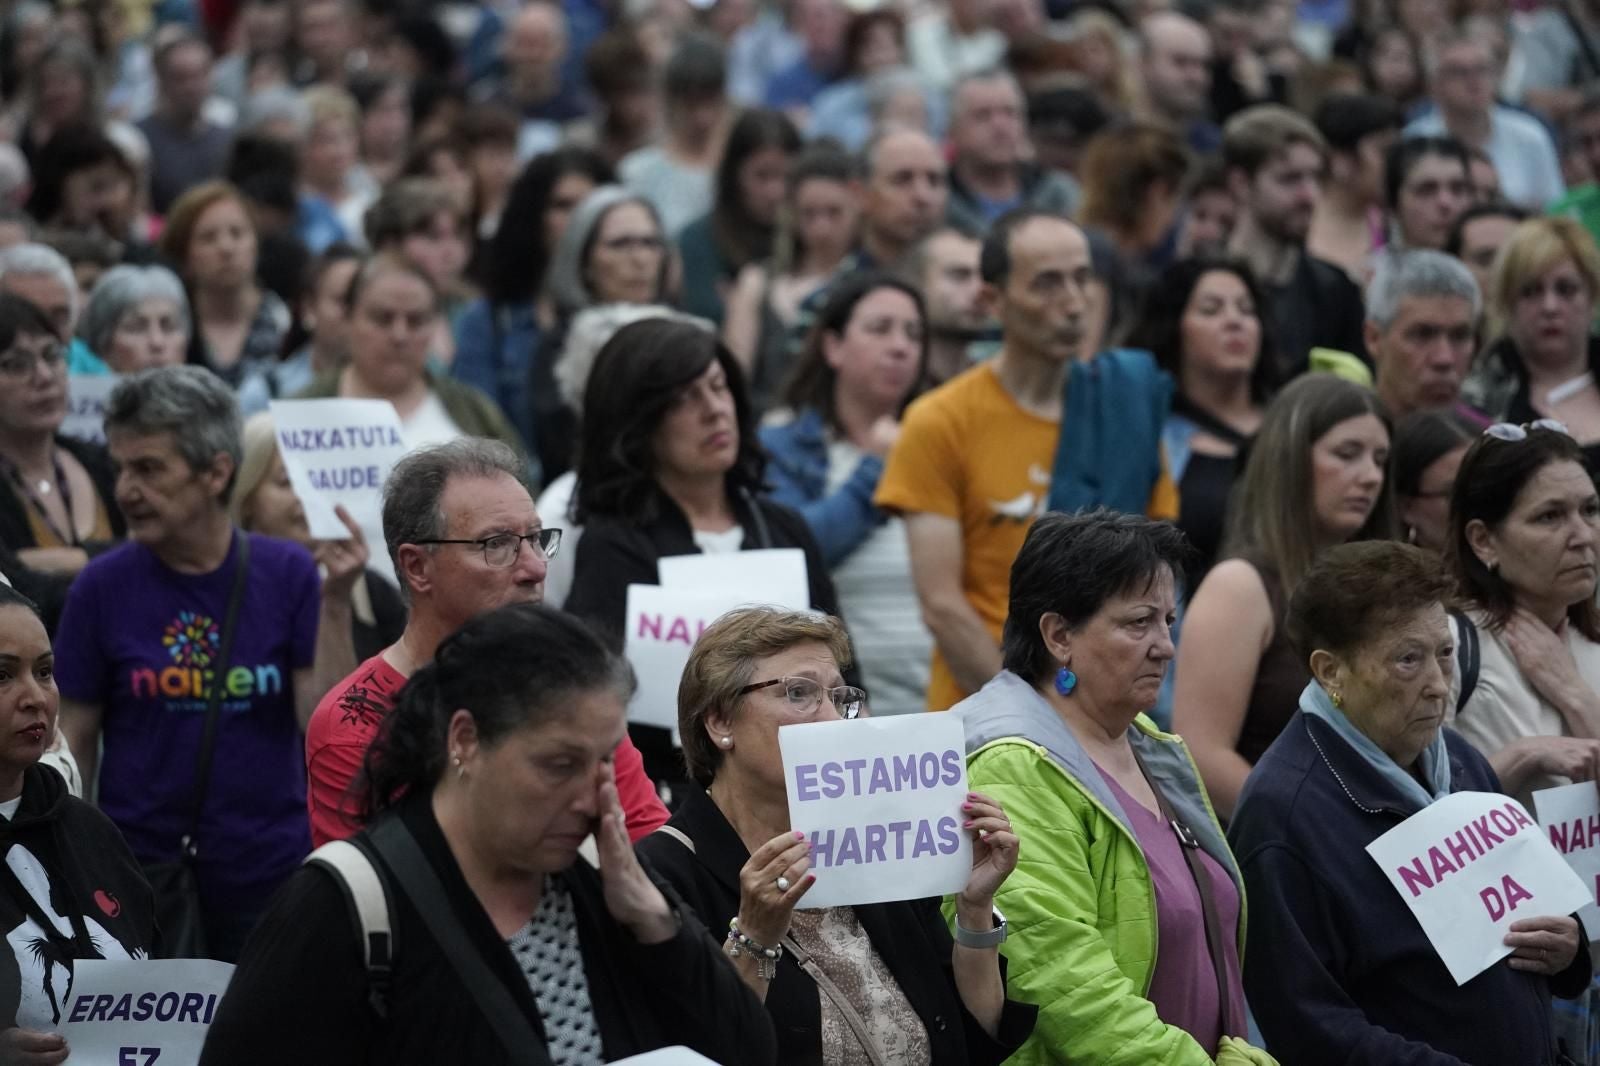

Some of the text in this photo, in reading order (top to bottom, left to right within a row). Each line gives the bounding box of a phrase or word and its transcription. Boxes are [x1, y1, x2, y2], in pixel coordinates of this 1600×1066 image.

[795, 750, 962, 801] ESTAMOS
[807, 816, 960, 869] HARTAS
[1397, 803, 1533, 897] NAHIKOA
[1479, 874, 1534, 923] DA
[68, 991, 217, 1024] ERASORI
